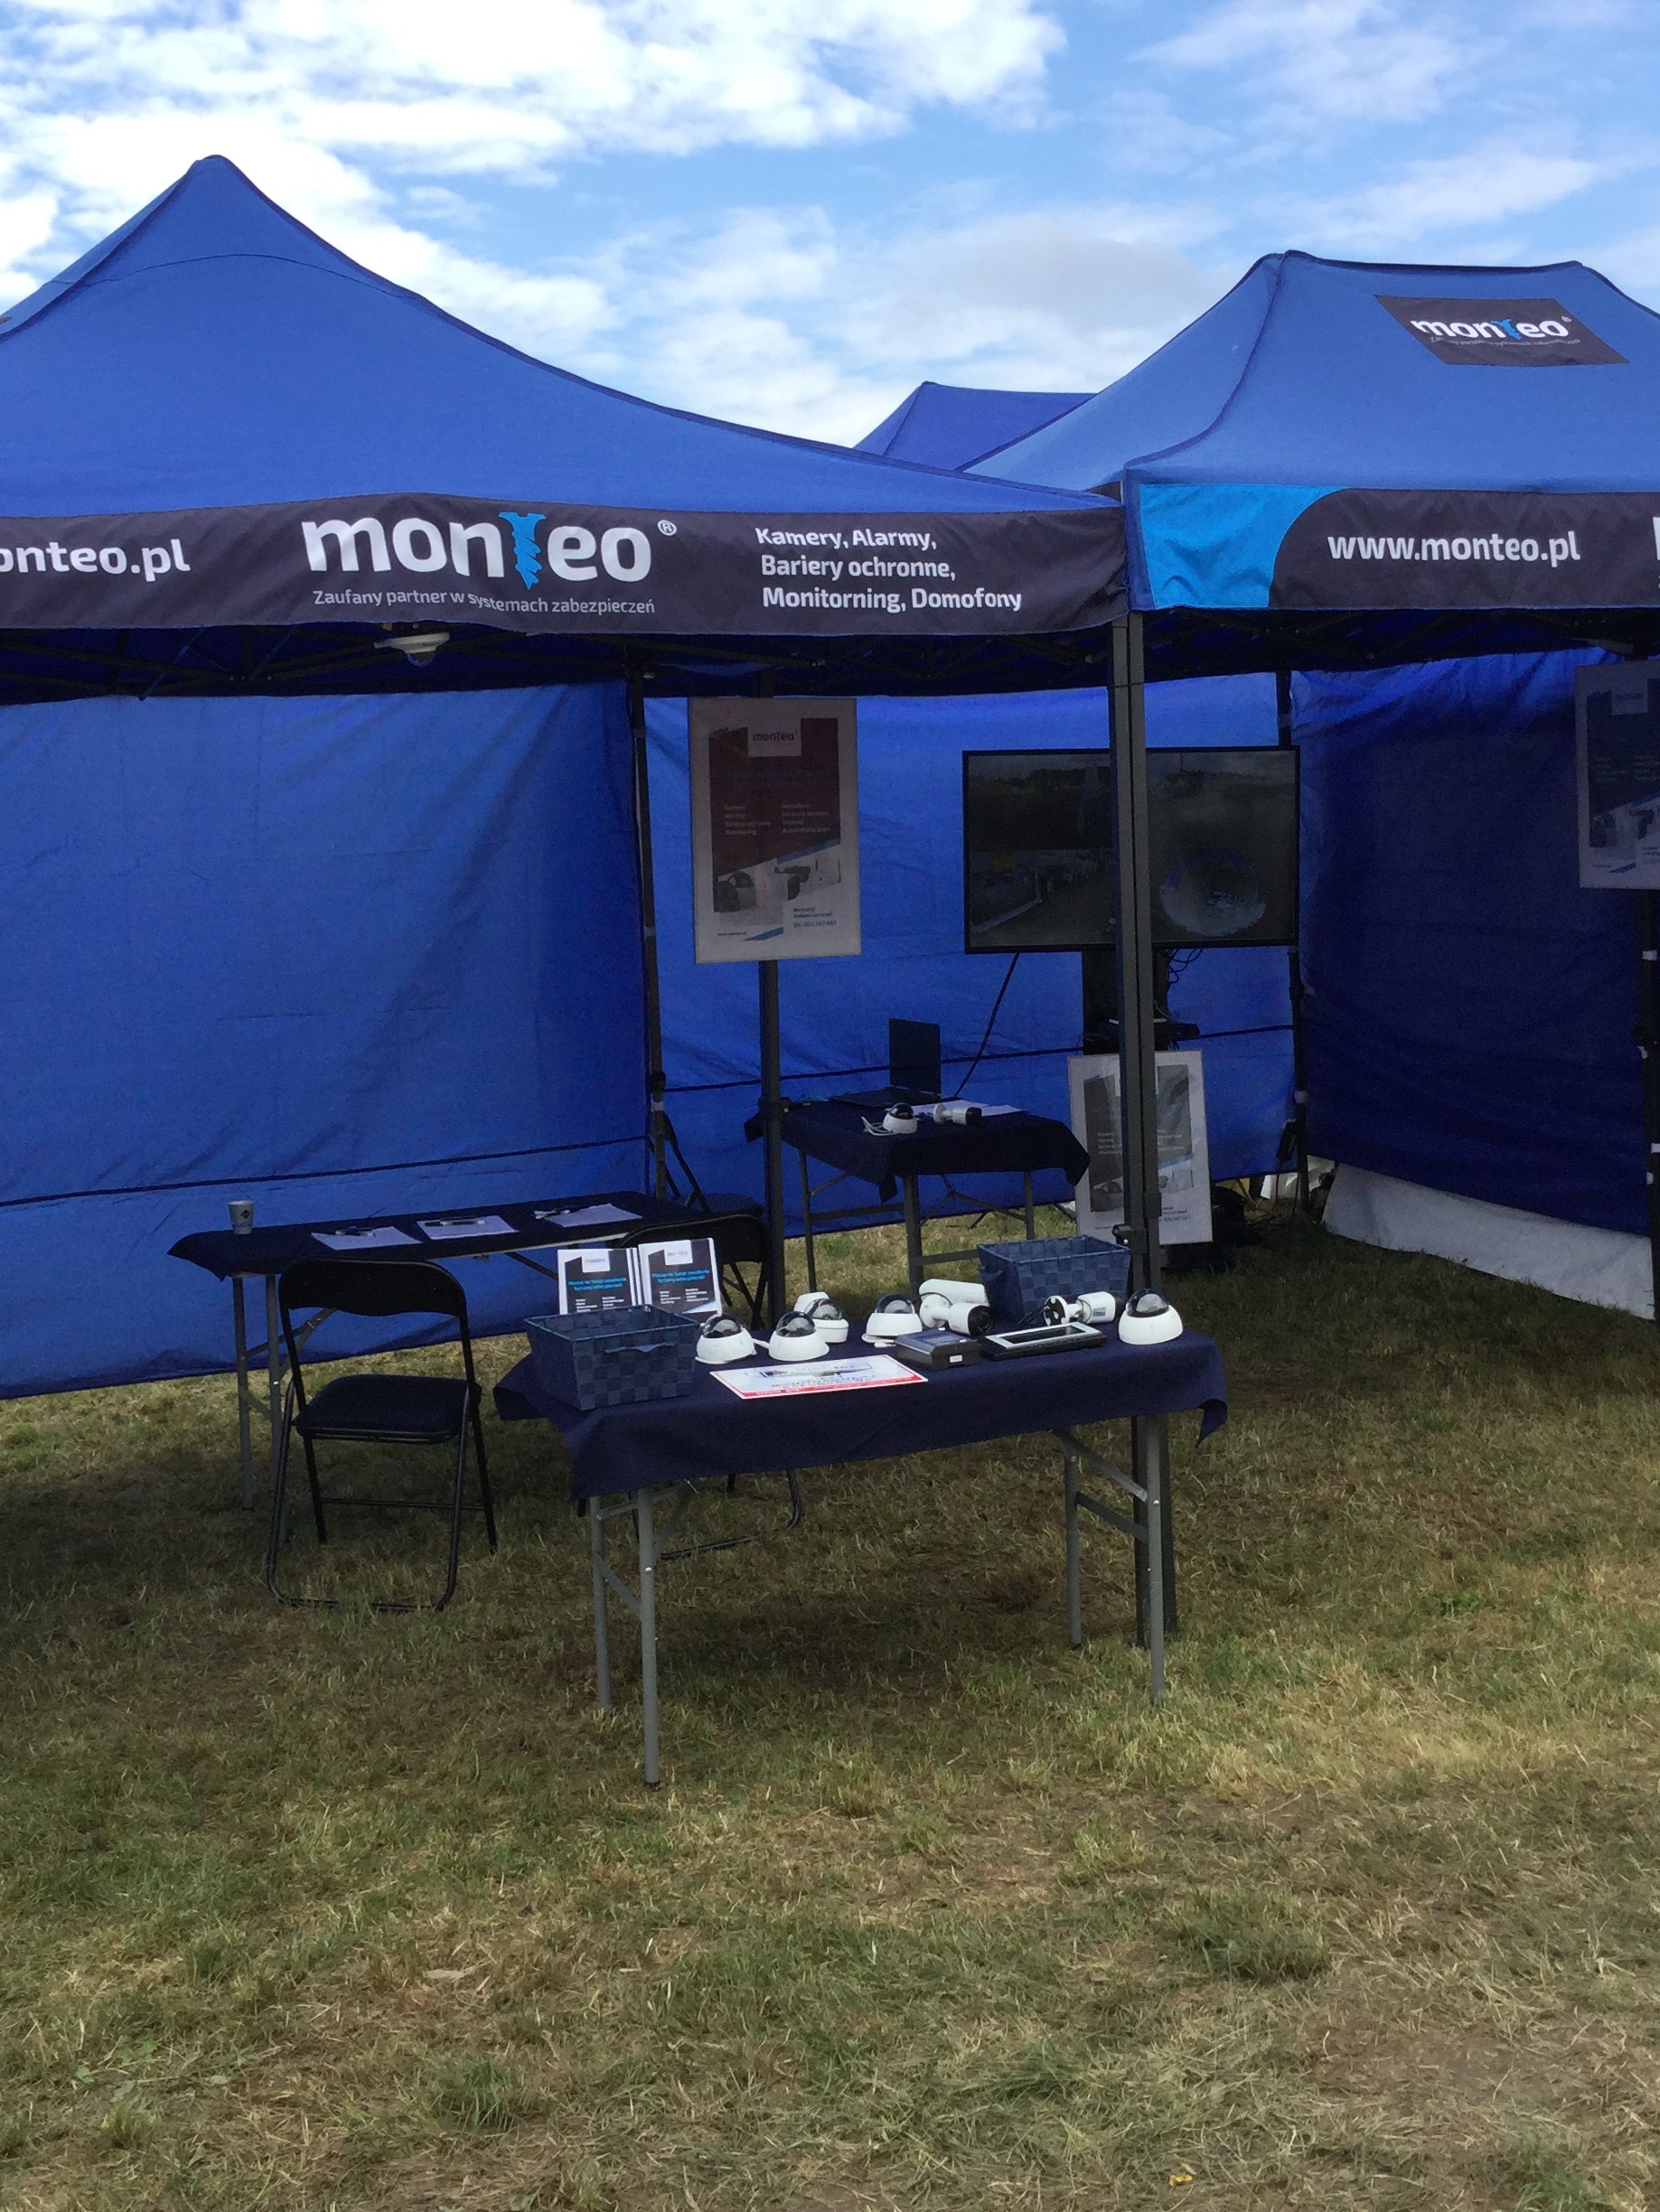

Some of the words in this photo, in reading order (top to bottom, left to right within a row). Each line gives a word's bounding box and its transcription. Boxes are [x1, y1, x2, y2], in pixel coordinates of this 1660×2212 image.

[755, 527, 849, 549] Kamery,
[852, 528, 938, 550] Alarmy,
[1327, 530, 1581, 568] www.monteo.pl
[761, 554, 844, 581] Bariery
[848, 556, 956, 581] ochronne,
[313, 589, 382, 606] Zaufany
[386, 590, 447, 606] partner
[450, 592, 464, 604] w
[467, 594, 549, 613] systemach
[551, 597, 656, 615] zabezpieczeń
[762, 586, 906, 613] Monitorning,
[911, 587, 1022, 611] Domofony
